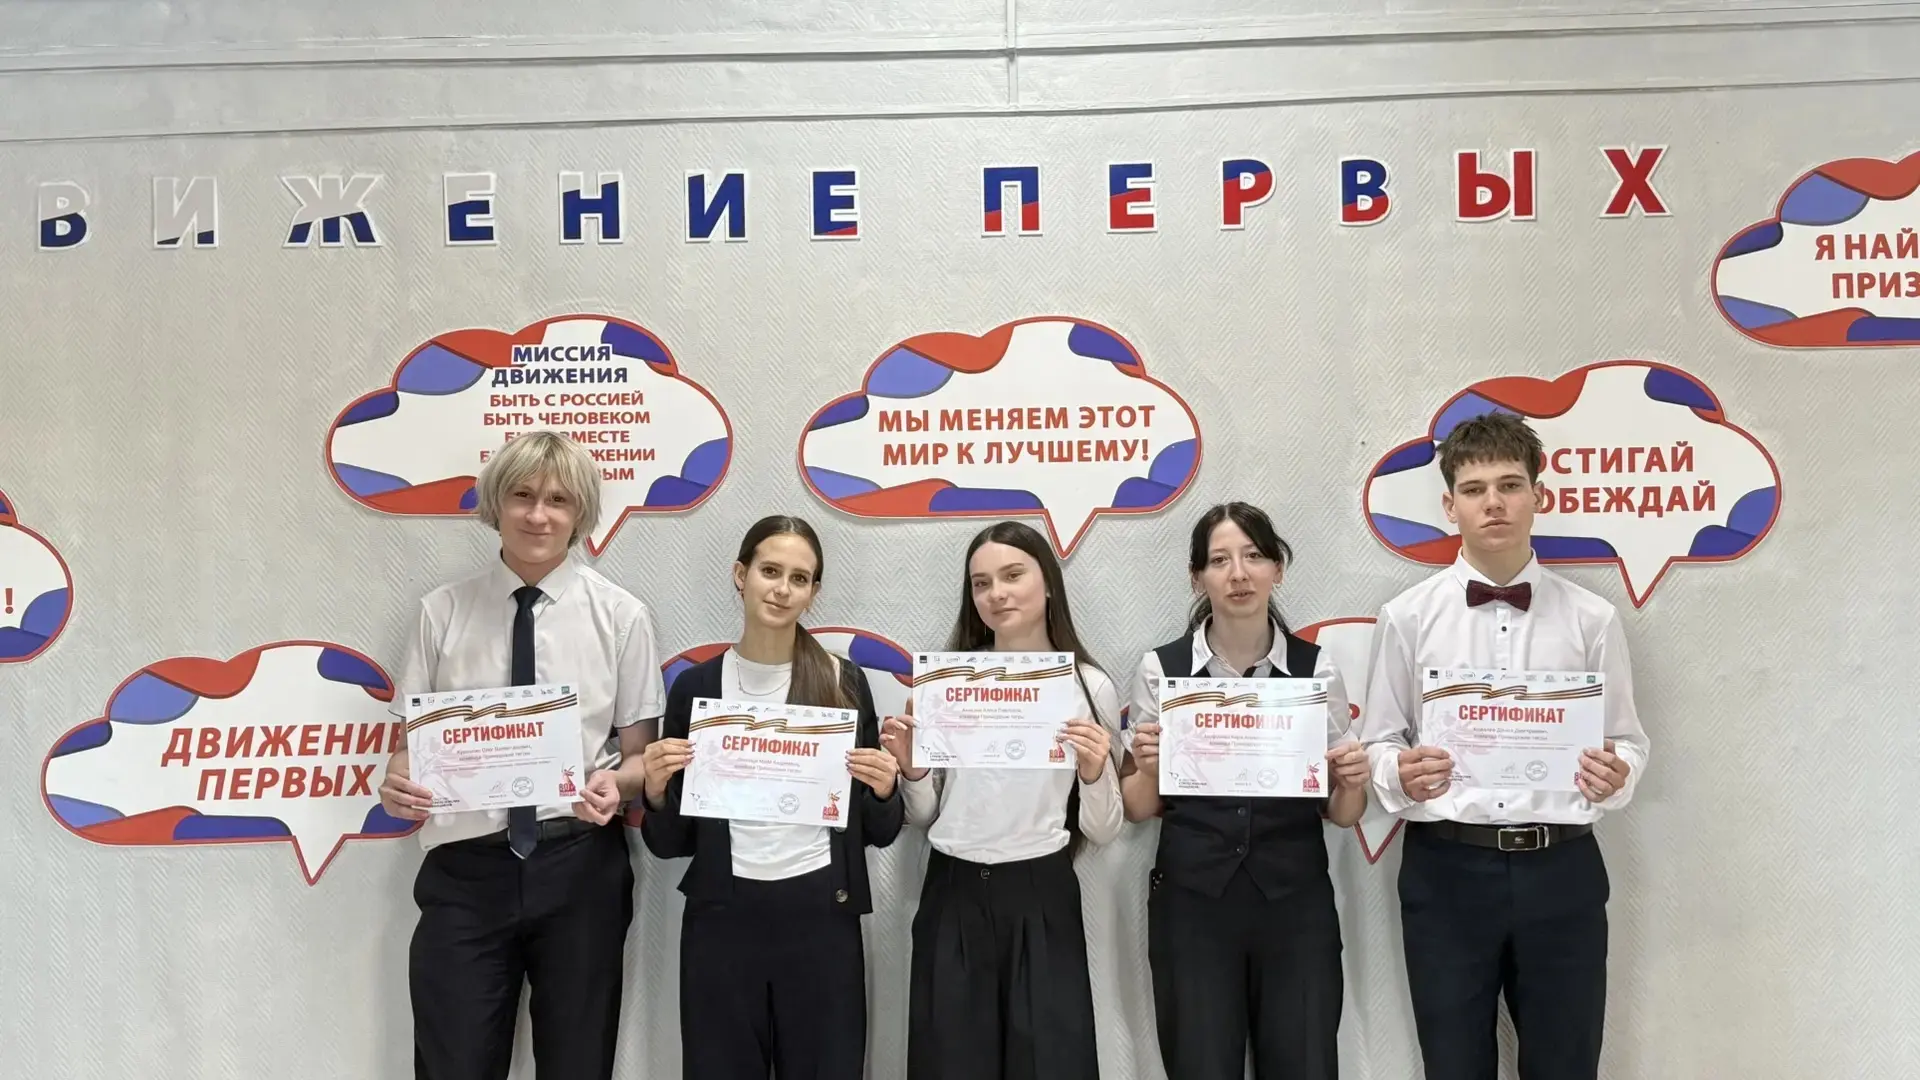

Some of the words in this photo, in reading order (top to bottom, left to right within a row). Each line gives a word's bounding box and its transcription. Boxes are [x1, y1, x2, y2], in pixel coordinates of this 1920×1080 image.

[983, 147, 1668, 235] ПЕРВЫХ
[1815, 234, 1835, 260] Я
[1844, 228, 1919, 260] НАЙ
[1832, 271, 1920, 299] ПРИЗ
[513, 346, 611, 363] МИССИЯ
[491, 367, 627, 388] ДВИЖЕНИЯ
[490, 395, 540, 407] БЫТЬ
[544, 394, 556, 407] С
[560, 390, 644, 407] РОССИЕЙ
[484, 413, 533, 426] БЫТЬ
[538, 411, 650, 425] ЧЕЛОВЕКОМ
[878, 410, 929, 432] МЫ
[939, 407, 1069, 431] МЕНЯЕМ
[1079, 405, 1155, 428] ЭТОТ
[588, 449, 655, 462] ЖЕНИИ
[883, 443, 949, 465] МИР
[957, 443, 975, 464] К
[984, 439, 1149, 464] ЛУЧШЕМУ!
[1536, 441, 1694, 475] СТИГАЙ
[1540, 480, 1716, 518] ОБЕЖДАЙ
[946, 687, 1040, 702] СЕРТИФИКАТ
[1459, 704, 1565, 723] СЕРТИФИКАТ
[443, 721, 544, 744] СЕРТИФИКАТ
[722, 735, 819, 757] СЕРТИФИКАТ
[197, 764, 376, 800] ПЕРВЫХ
